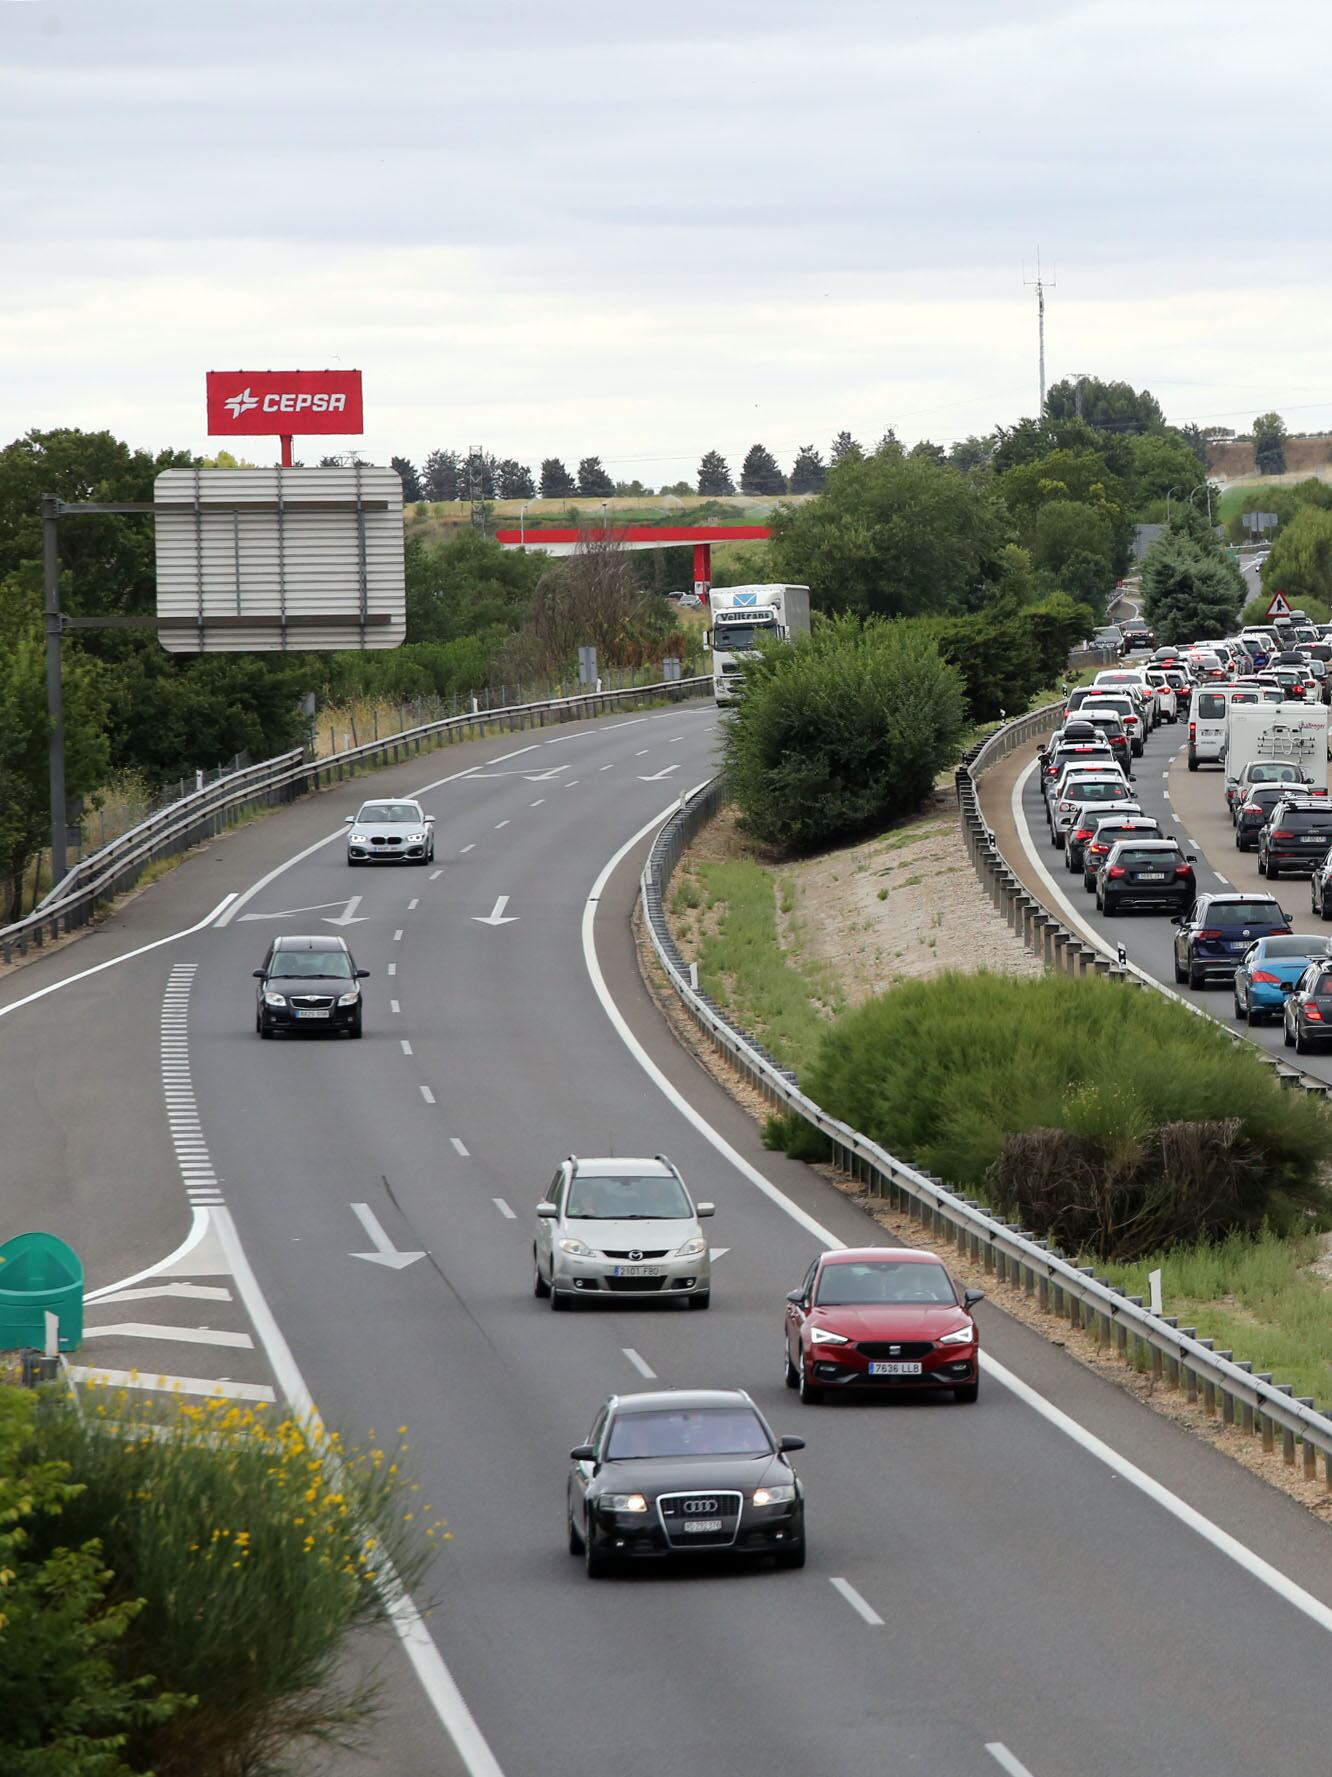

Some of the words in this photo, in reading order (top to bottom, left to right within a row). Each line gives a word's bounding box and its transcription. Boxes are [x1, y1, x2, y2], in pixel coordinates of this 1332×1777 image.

[262, 393, 346, 412] CEPSA
[876, 1364, 899, 1373] 7636
[901, 1364, 919, 1373] LLB
